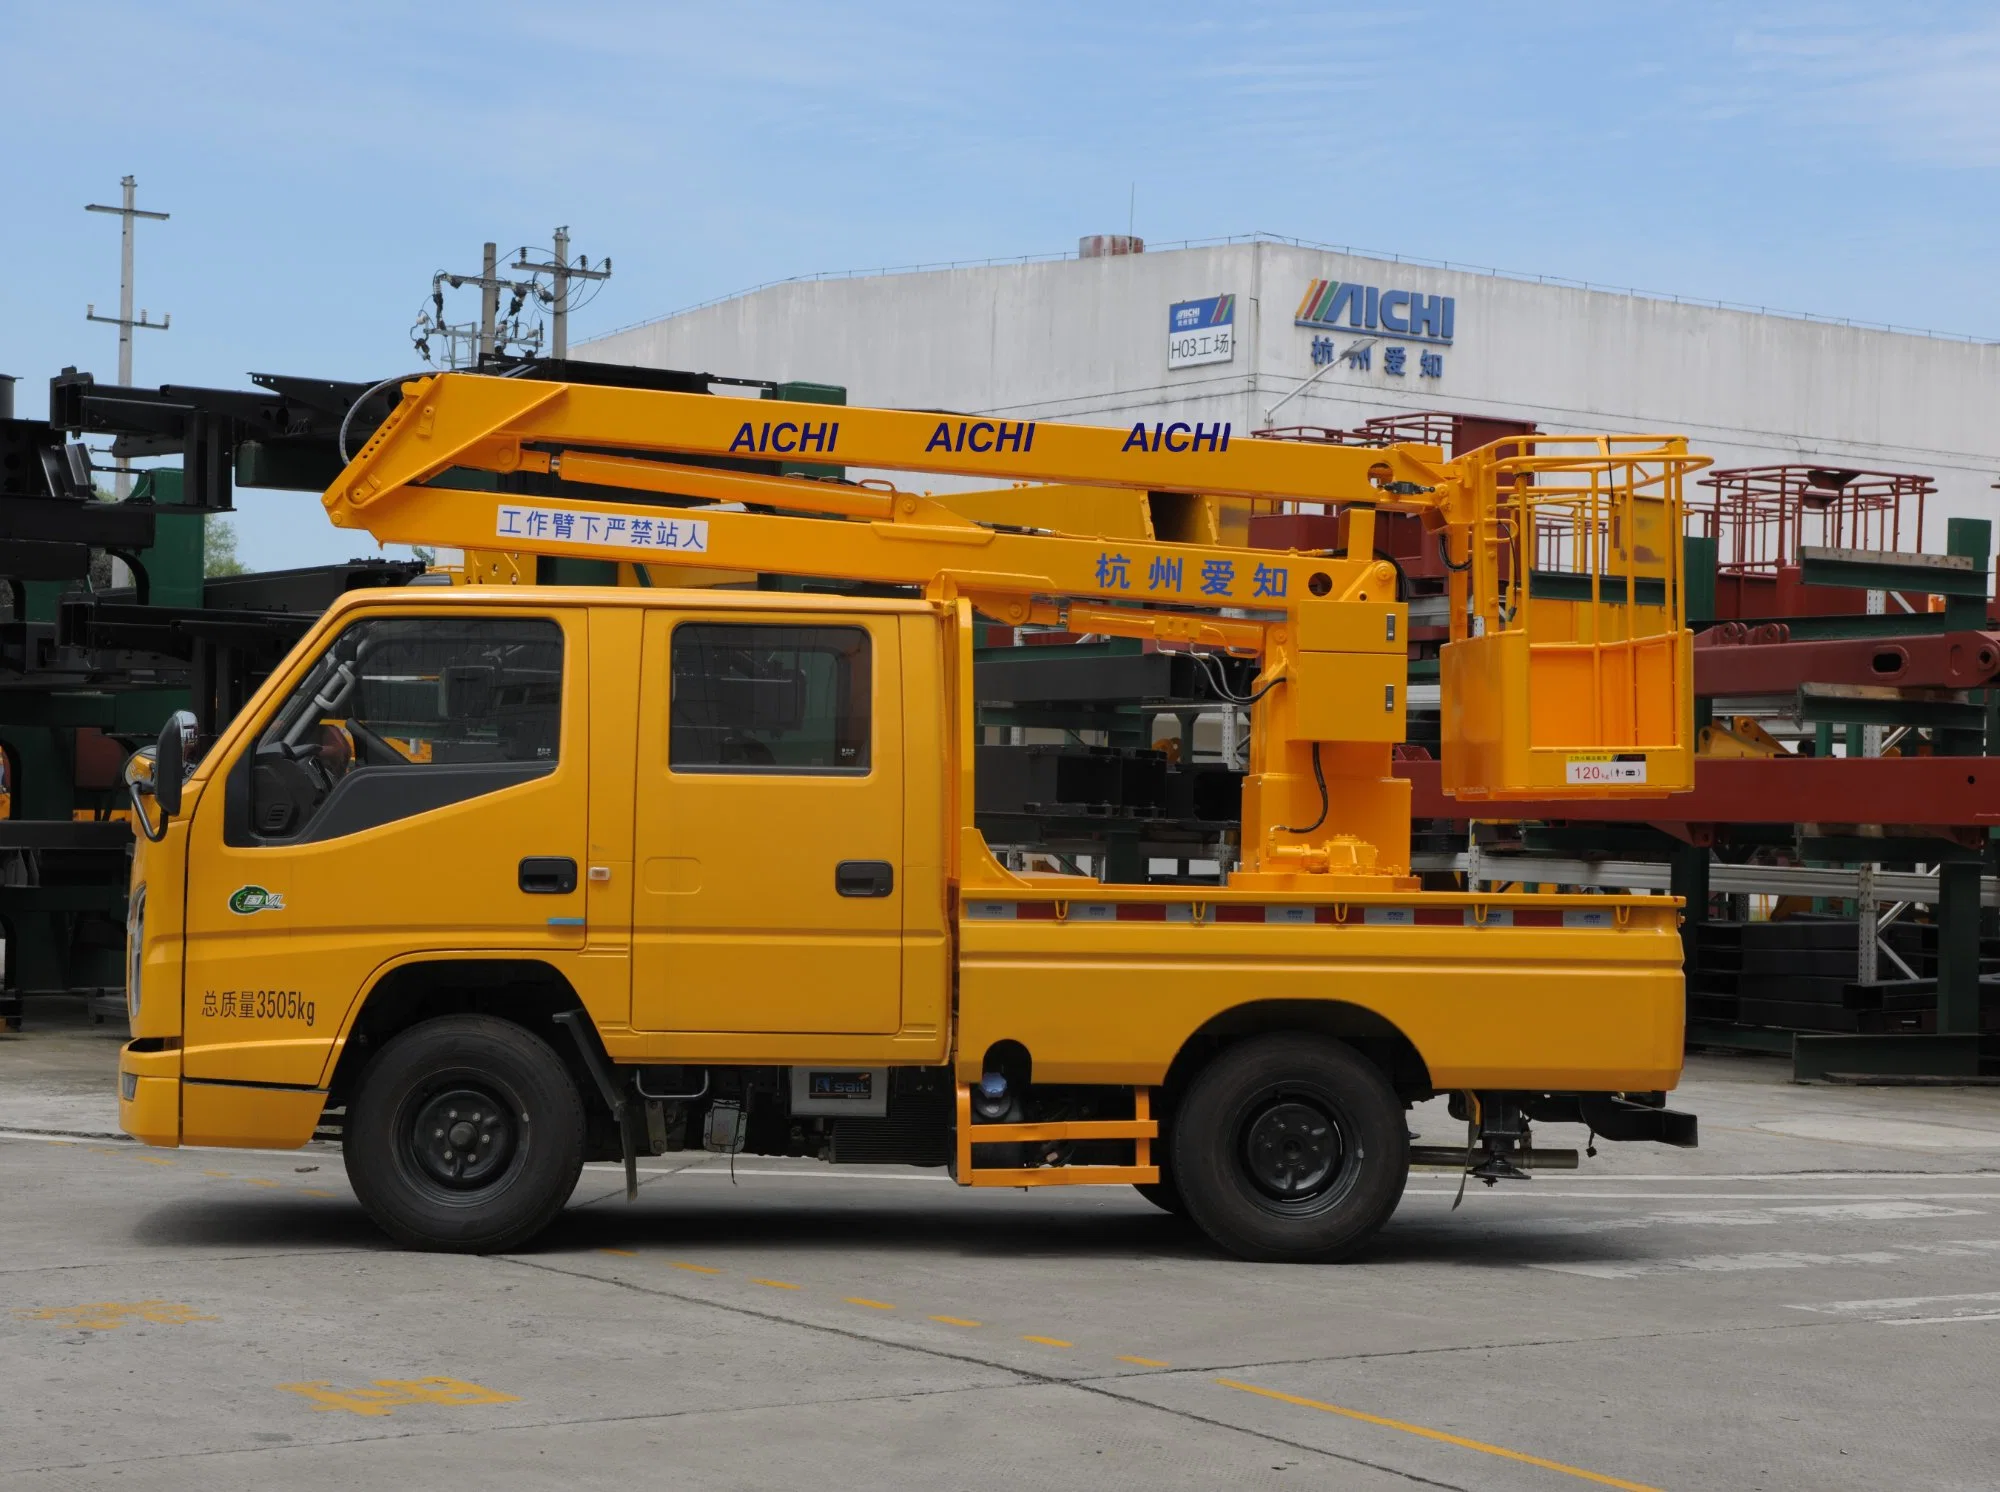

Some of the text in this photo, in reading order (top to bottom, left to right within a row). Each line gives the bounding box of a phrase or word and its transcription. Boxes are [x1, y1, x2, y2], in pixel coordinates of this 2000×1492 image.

[1322, 281, 1455, 339] AICHI
[1170, 333, 1229, 359] H03工场
[729, 422, 1232, 453] AICHI AICHI AICHI
[499, 509, 705, 550] 工作臂下严禁站人
[1094, 552, 1289, 598] 杭州爱知
[201, 989, 316, 1028] 总质量3505kg
